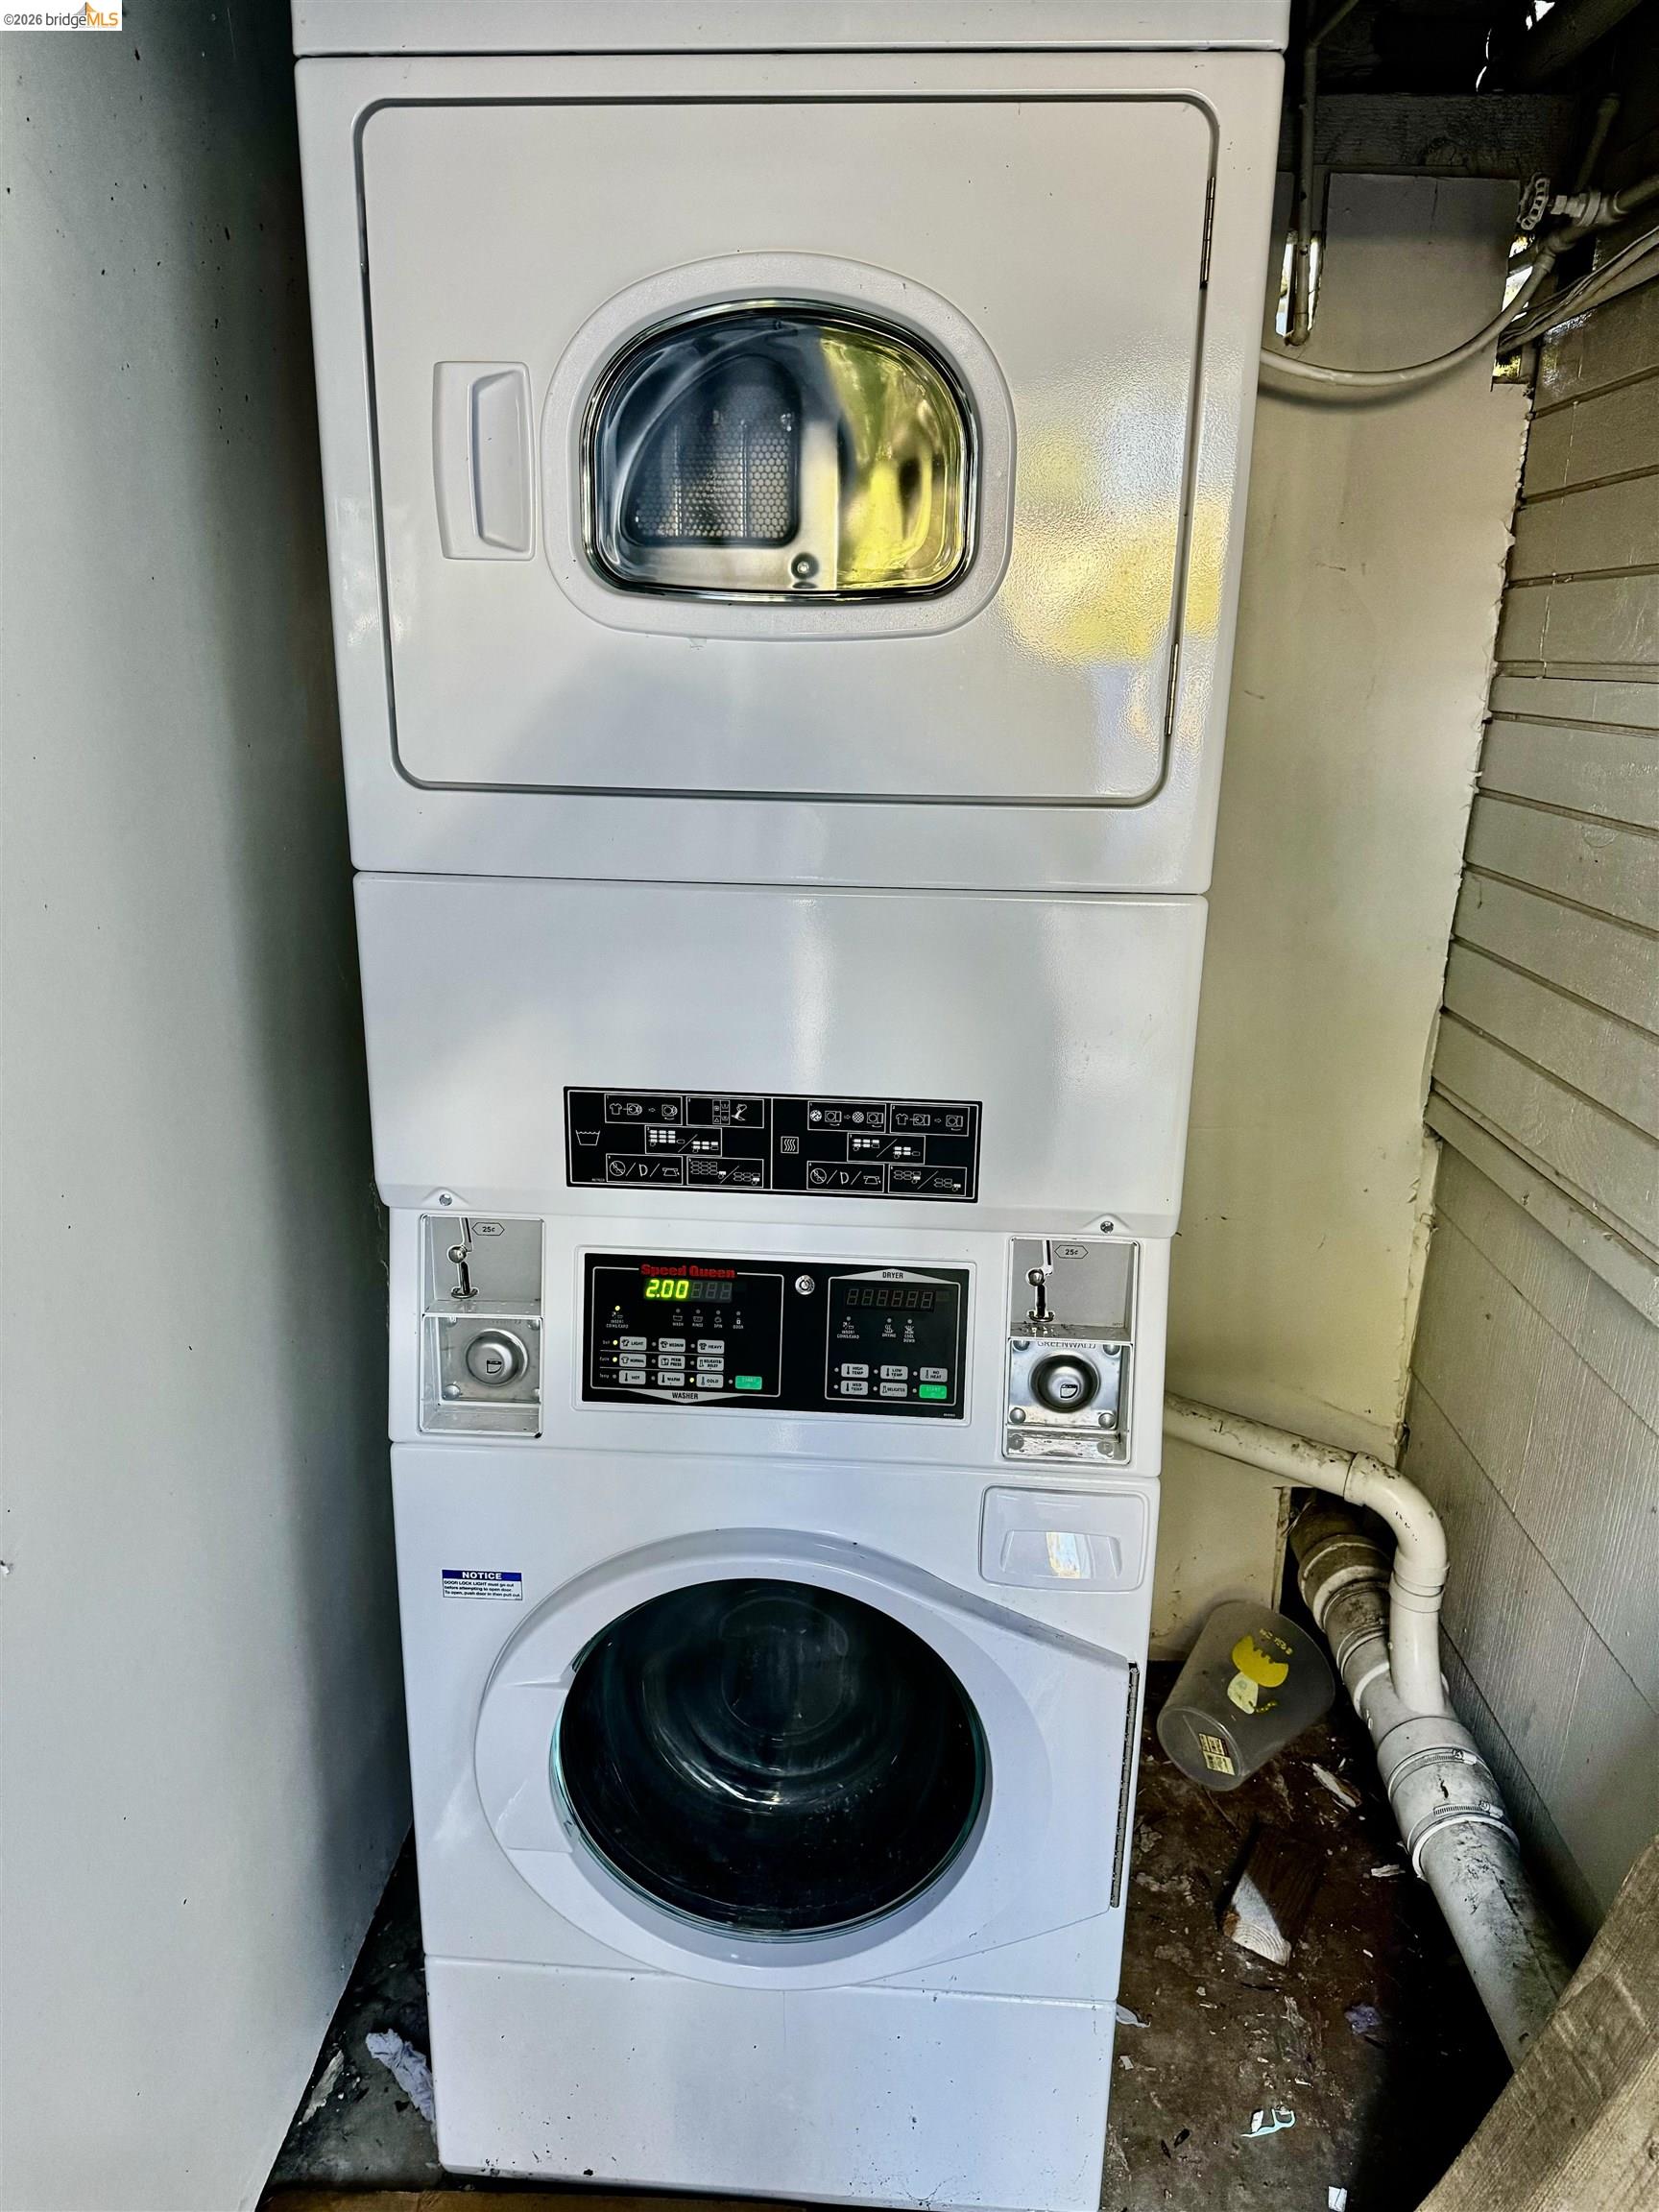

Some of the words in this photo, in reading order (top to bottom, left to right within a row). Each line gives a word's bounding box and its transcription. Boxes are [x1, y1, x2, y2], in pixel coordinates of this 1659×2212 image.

[641, 1263, 686, 1277] Speed
[688, 1264, 735, 1278] Queen
[645, 1279, 689, 1298] 2.00
[462, 1572, 502, 1580] NOTICE
